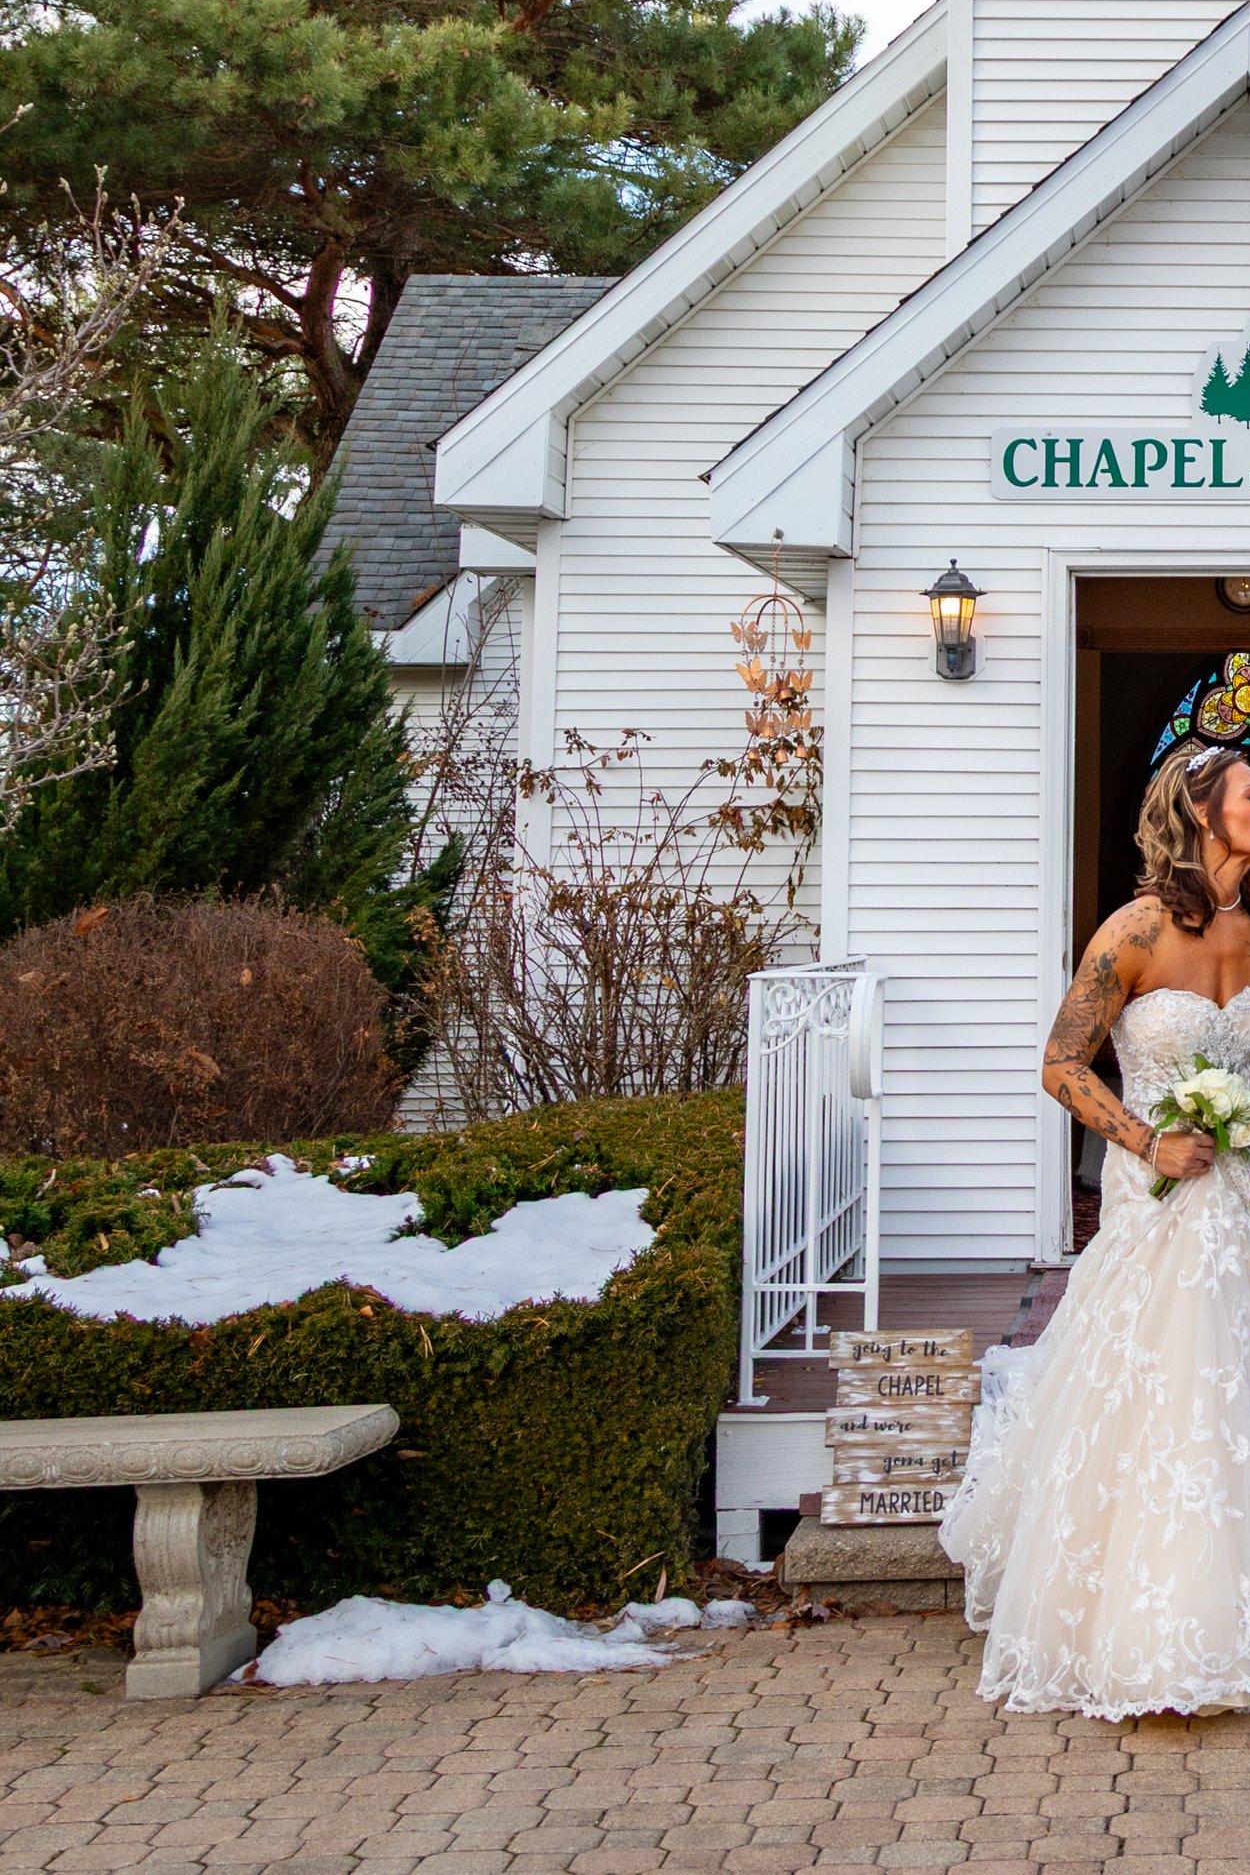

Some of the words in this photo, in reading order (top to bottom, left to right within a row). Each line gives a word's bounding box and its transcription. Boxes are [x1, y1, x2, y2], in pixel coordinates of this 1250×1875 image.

[1003, 438, 1243, 488] CHAPEL
[853, 1342, 891, 1361] going
[901, 1340, 916, 1356] to
[923, 1341, 949, 1357] the
[878, 1375, 944, 1397] CHAPEL
[840, 1415, 868, 1431] and
[883, 1456, 925, 1474] gonna
